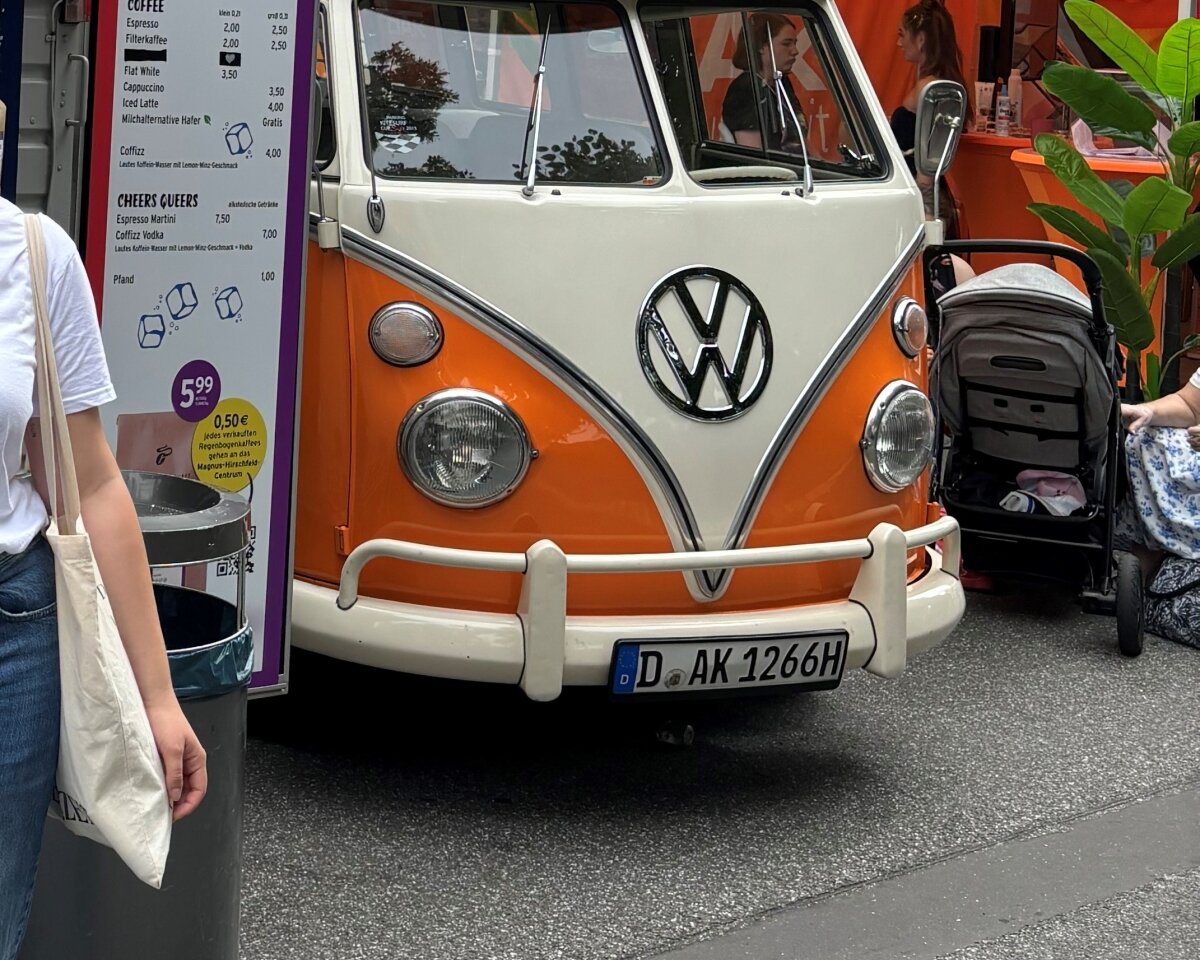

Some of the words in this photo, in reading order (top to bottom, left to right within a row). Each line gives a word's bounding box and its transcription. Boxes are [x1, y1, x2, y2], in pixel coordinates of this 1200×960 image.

[127, 19, 159, 29] Espresso
[224, 23, 240, 33] 2,00
[272, 26, 288, 35] 2,50
[126, 34, 168, 45] Filterkaffee
[223, 39, 240, 48] 2,00
[271, 41, 287, 51] 2,50
[125, 66, 138, 76] Flat
[140, 67, 160, 77] White
[222, 70, 238, 79] 3,50
[124, 82, 165, 94] Cappuccino
[269, 87, 285, 97] 3,50
[123, 98, 138, 108] Iced
[140, 99, 159, 108] Latte
[268, 103, 284, 112] 4,00
[122, 114, 180, 125] Milchalternative
[181, 115, 201, 126] Hafer
[263, 117, 283, 127] Gratis
[120, 146, 145, 156] Coffizz
[266, 149, 282, 158] 4,00
[118, 194, 157, 208] CHEERS
[160, 194, 199, 210] QUEERS
[117, 214, 149, 225] Espresso
[151, 214, 176, 224] Martini
[215, 214, 231, 224] 7,50
[116, 230, 141, 240] Coffizz
[143, 230, 164, 240] Vodka
[263, 229, 278, 239] 7,00
[113, 274, 135, 284] Pfand
[261, 272, 275, 281] 1,00
[214, 414, 239, 430] 0,50
[241, 415, 249, 426] €
[204, 432, 221, 441] jedes
[215, 471, 243, 479] Centrum
[636, 650, 663, 688] D
[688, 648, 733, 686] AK
[738, 641, 843, 683] 1266H
